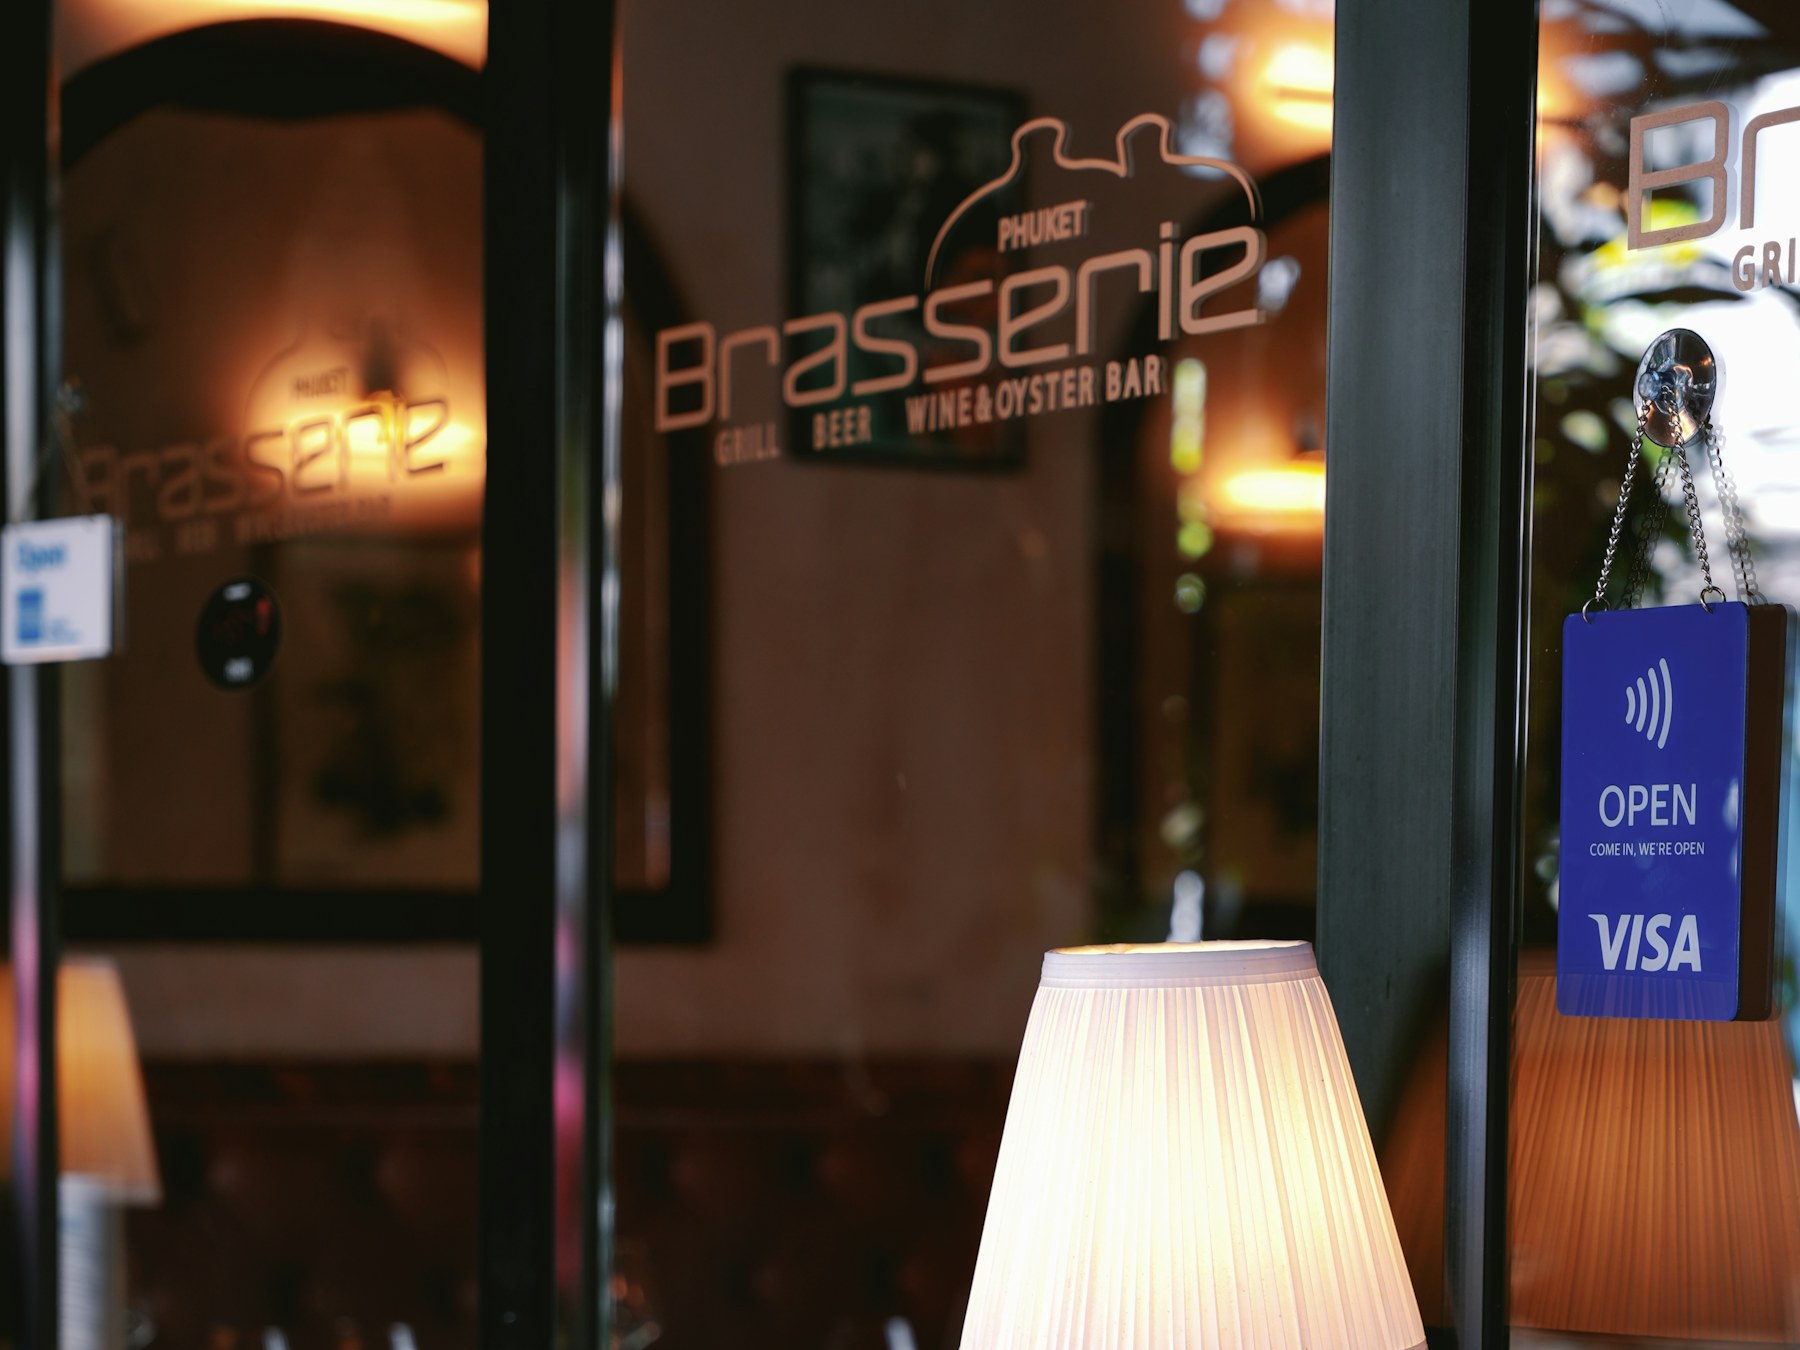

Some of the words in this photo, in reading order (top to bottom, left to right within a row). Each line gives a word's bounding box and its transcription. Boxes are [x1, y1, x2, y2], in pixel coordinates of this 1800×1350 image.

[998, 200, 1087, 253] PHUKET
[1732, 237, 1797, 291] GRI
[656, 221, 1259, 432] Brasserie
[715, 421, 781, 467] GRILL
[813, 405, 872, 450] BEER
[1105, 354, 1161, 402] BAR
[1598, 783, 1697, 827] OPEN
[1589, 843, 1621, 856] COME
[1622, 843, 1637, 857] IN,
[1638, 842, 1672, 856] WE'RE
[1674, 841, 1705, 855] OPEN
[1588, 913, 1702, 972] VISA
